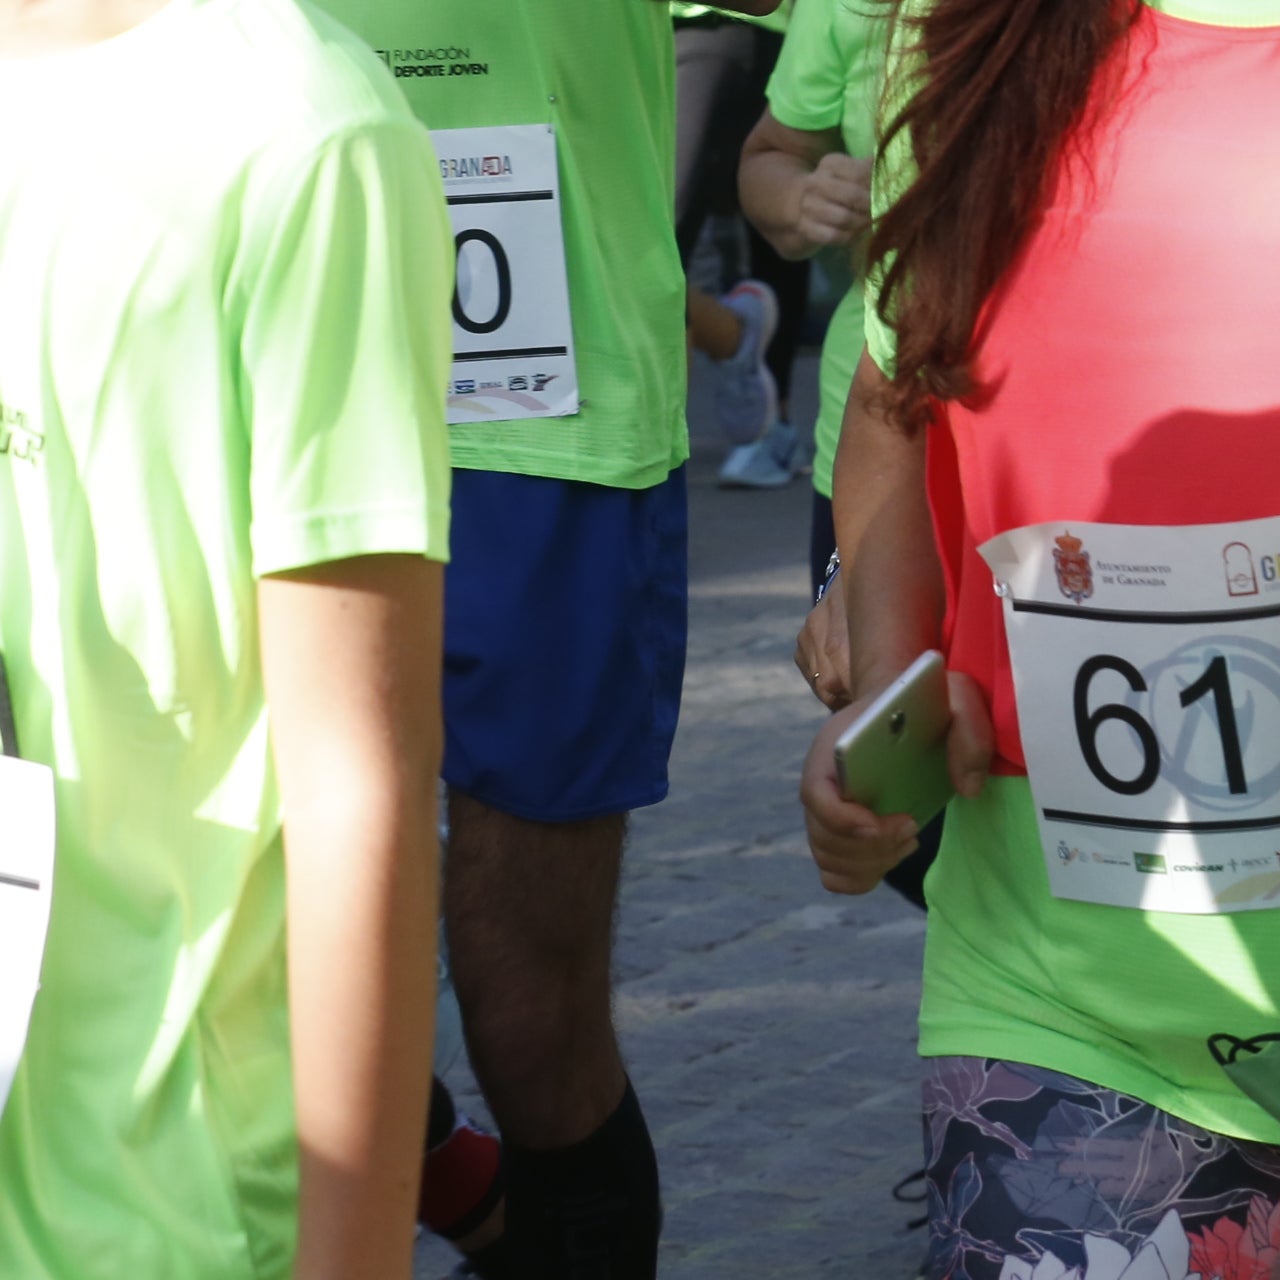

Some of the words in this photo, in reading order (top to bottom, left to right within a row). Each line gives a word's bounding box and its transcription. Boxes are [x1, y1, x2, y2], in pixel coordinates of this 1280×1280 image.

[393, 46, 470, 61] FUNDACIÓN
[394, 64, 445, 78] DEPORTE
[448, 63, 488, 76] JOVEN
